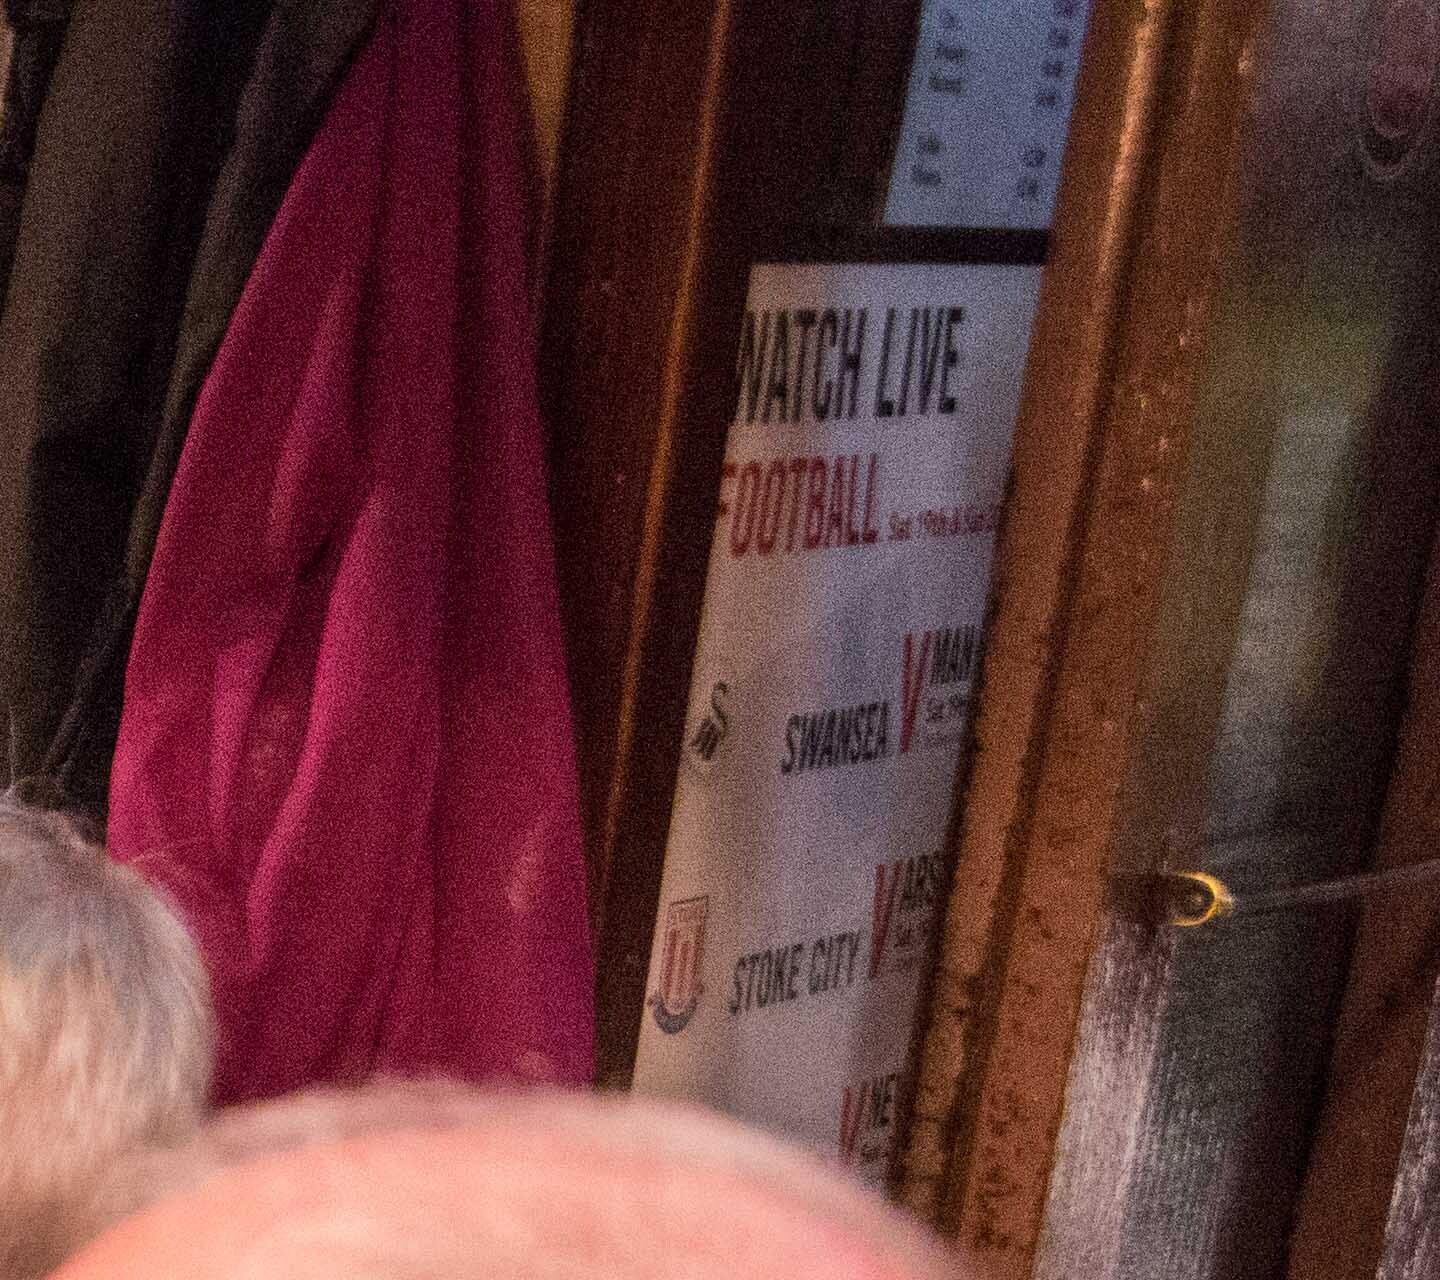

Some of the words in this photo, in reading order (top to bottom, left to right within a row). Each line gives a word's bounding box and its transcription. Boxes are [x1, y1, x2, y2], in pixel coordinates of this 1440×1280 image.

[875, 306, 963, 418] LIVE
[781, 700, 889, 774] SWANSEA
[729, 943, 804, 1015] STOKE
[804, 929, 862, 996] CITY
